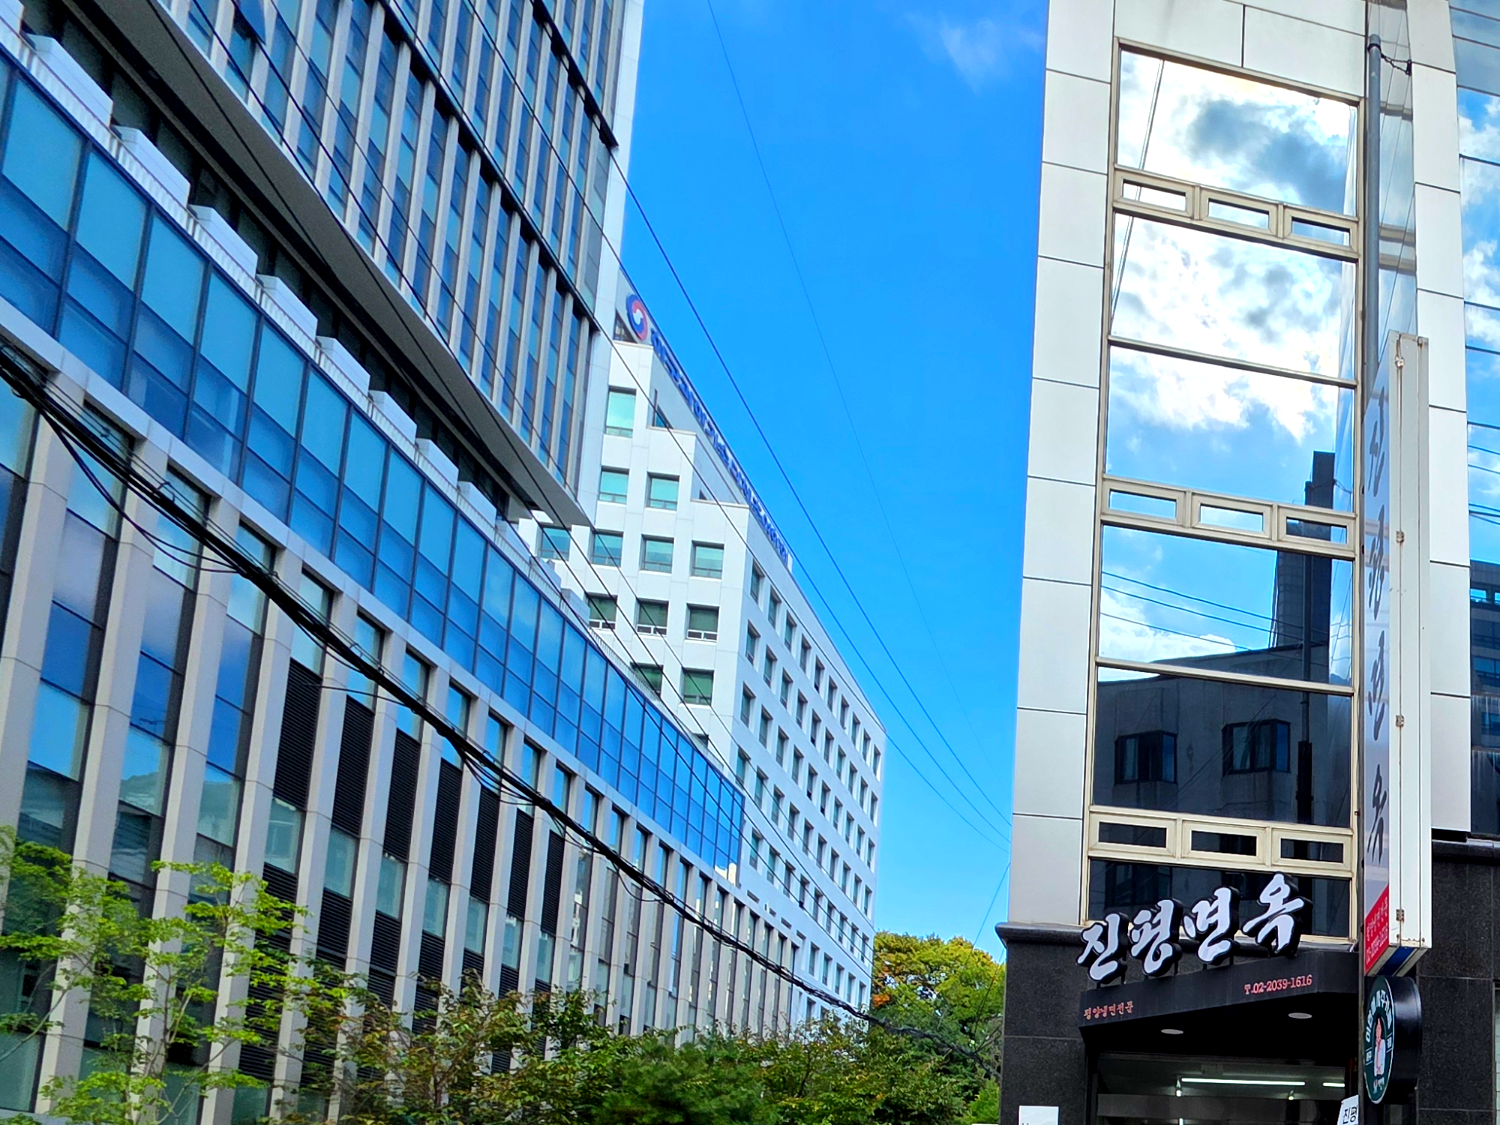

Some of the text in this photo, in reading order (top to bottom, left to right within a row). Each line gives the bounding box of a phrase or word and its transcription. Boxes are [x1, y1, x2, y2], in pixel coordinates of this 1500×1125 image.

[1367, 385, 1389, 869] 진평면옥
[1077, 872, 1306, 982] 진평면옥
[1083, 1000, 1134, 1020] 평양냉면전문
